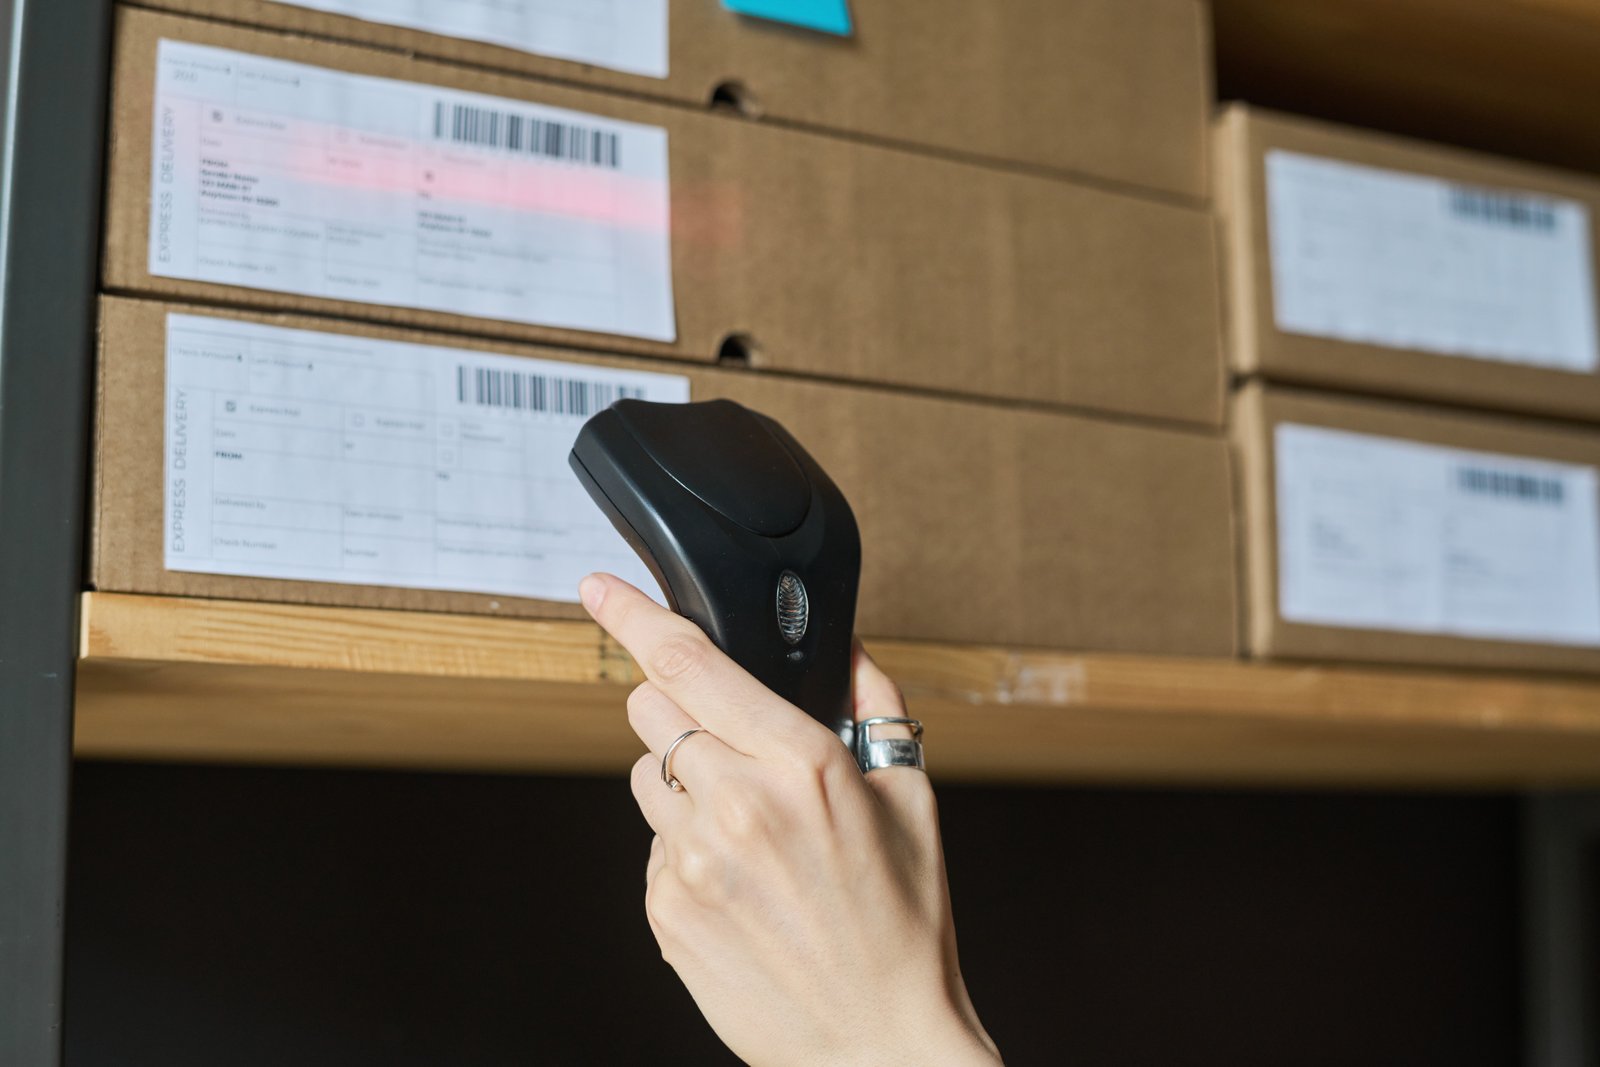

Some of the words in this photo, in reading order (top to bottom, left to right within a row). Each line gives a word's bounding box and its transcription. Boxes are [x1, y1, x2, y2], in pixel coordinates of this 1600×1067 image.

[160, 106, 176, 185] DELIVERY
[158, 190, 173, 263] EXPRESS
[173, 385, 188, 471] DELIVERY
[172, 478, 187, 553] EXPRESS
